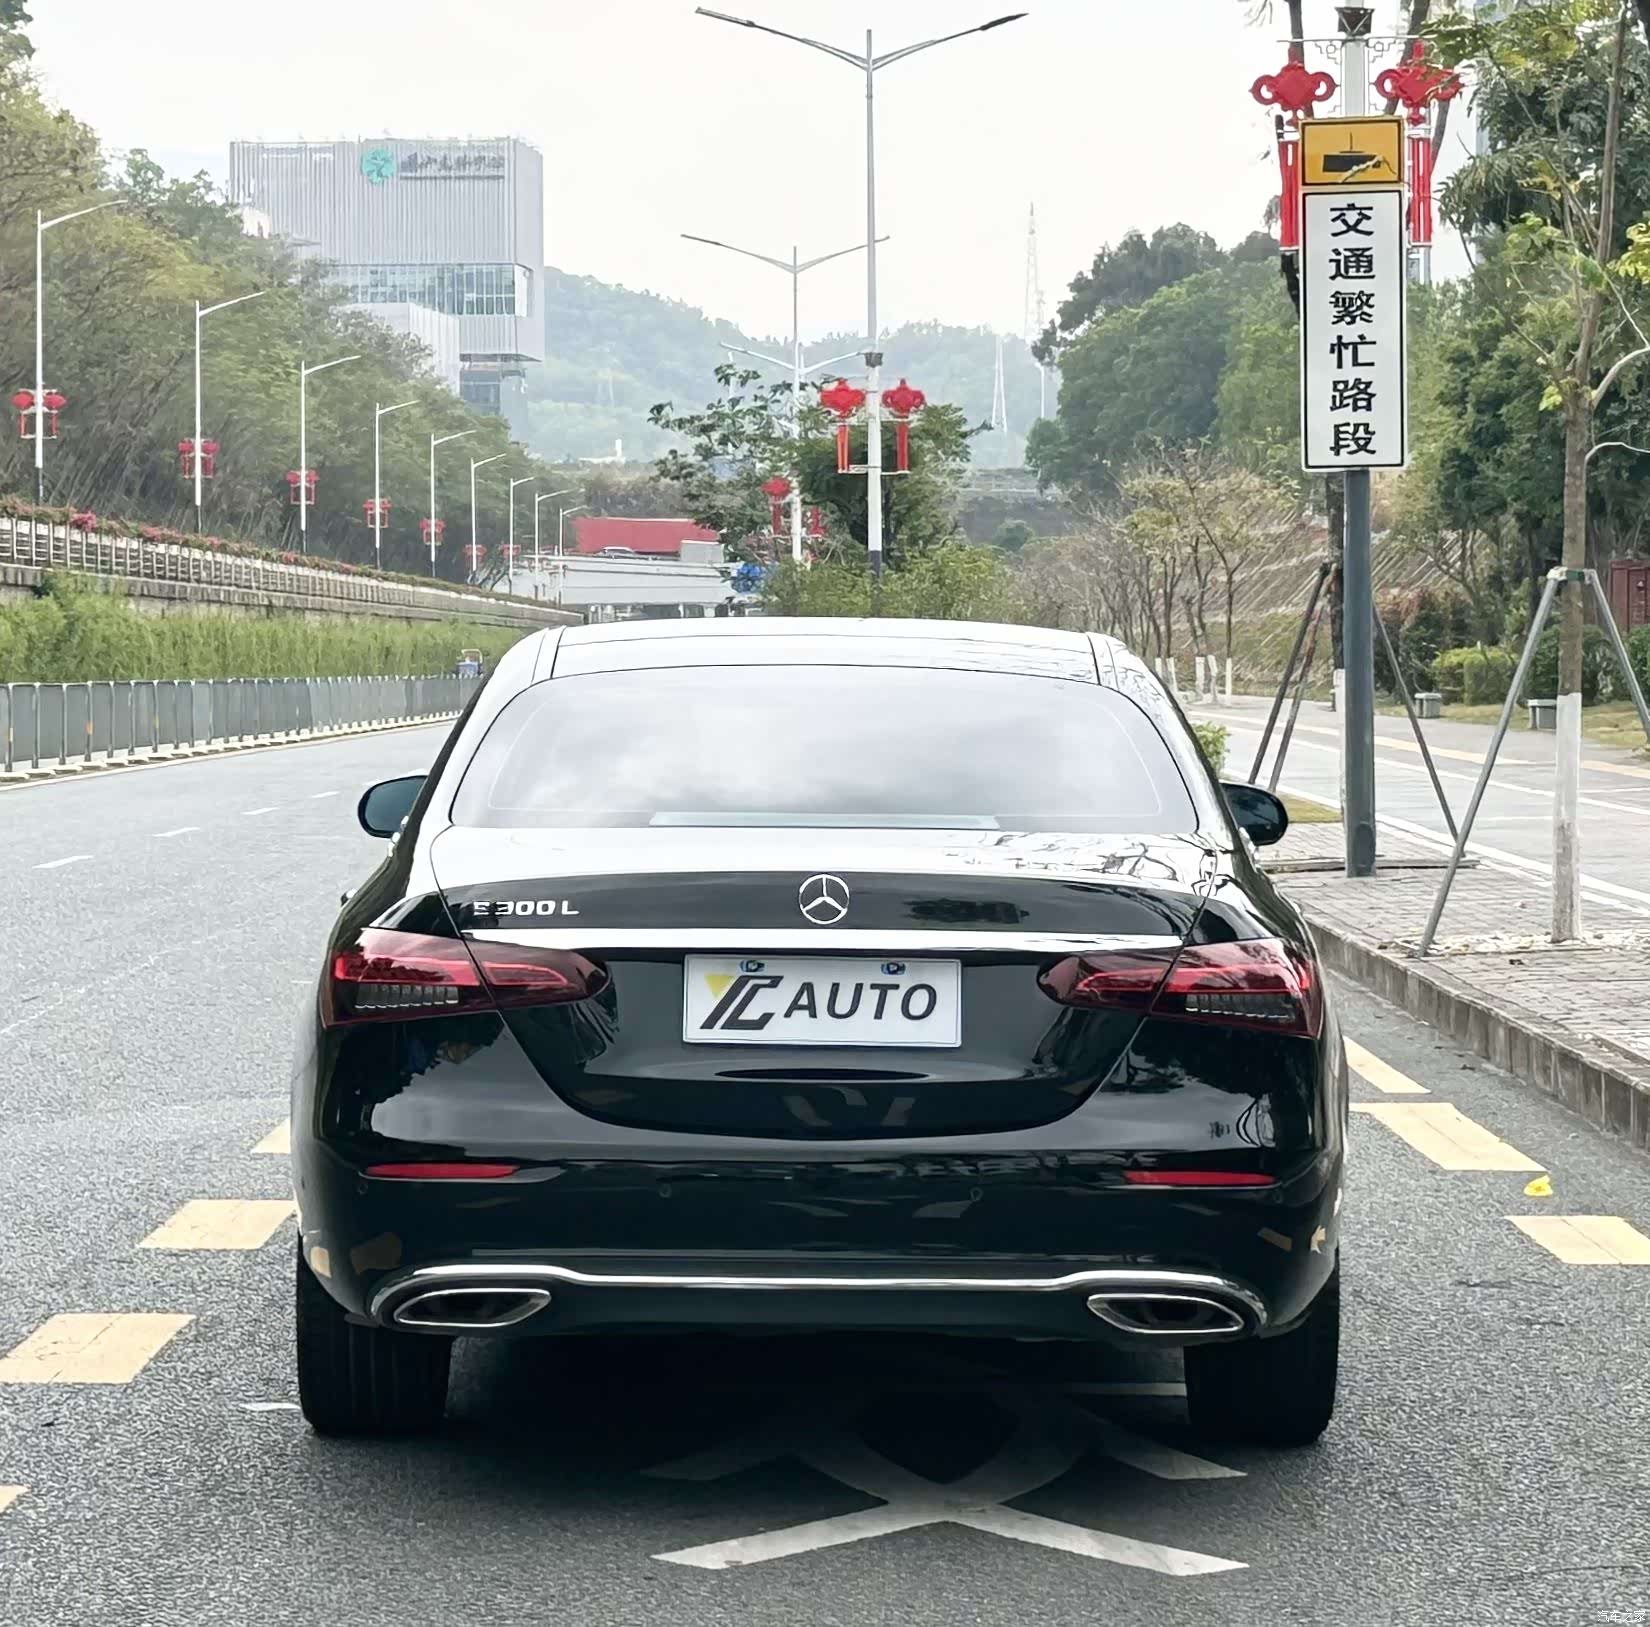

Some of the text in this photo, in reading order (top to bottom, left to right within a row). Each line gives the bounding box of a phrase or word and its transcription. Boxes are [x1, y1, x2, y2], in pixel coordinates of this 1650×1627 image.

[1329, 203, 1377, 456] 交通繁忙路段
[783, 981, 937, 1020] AUTO
